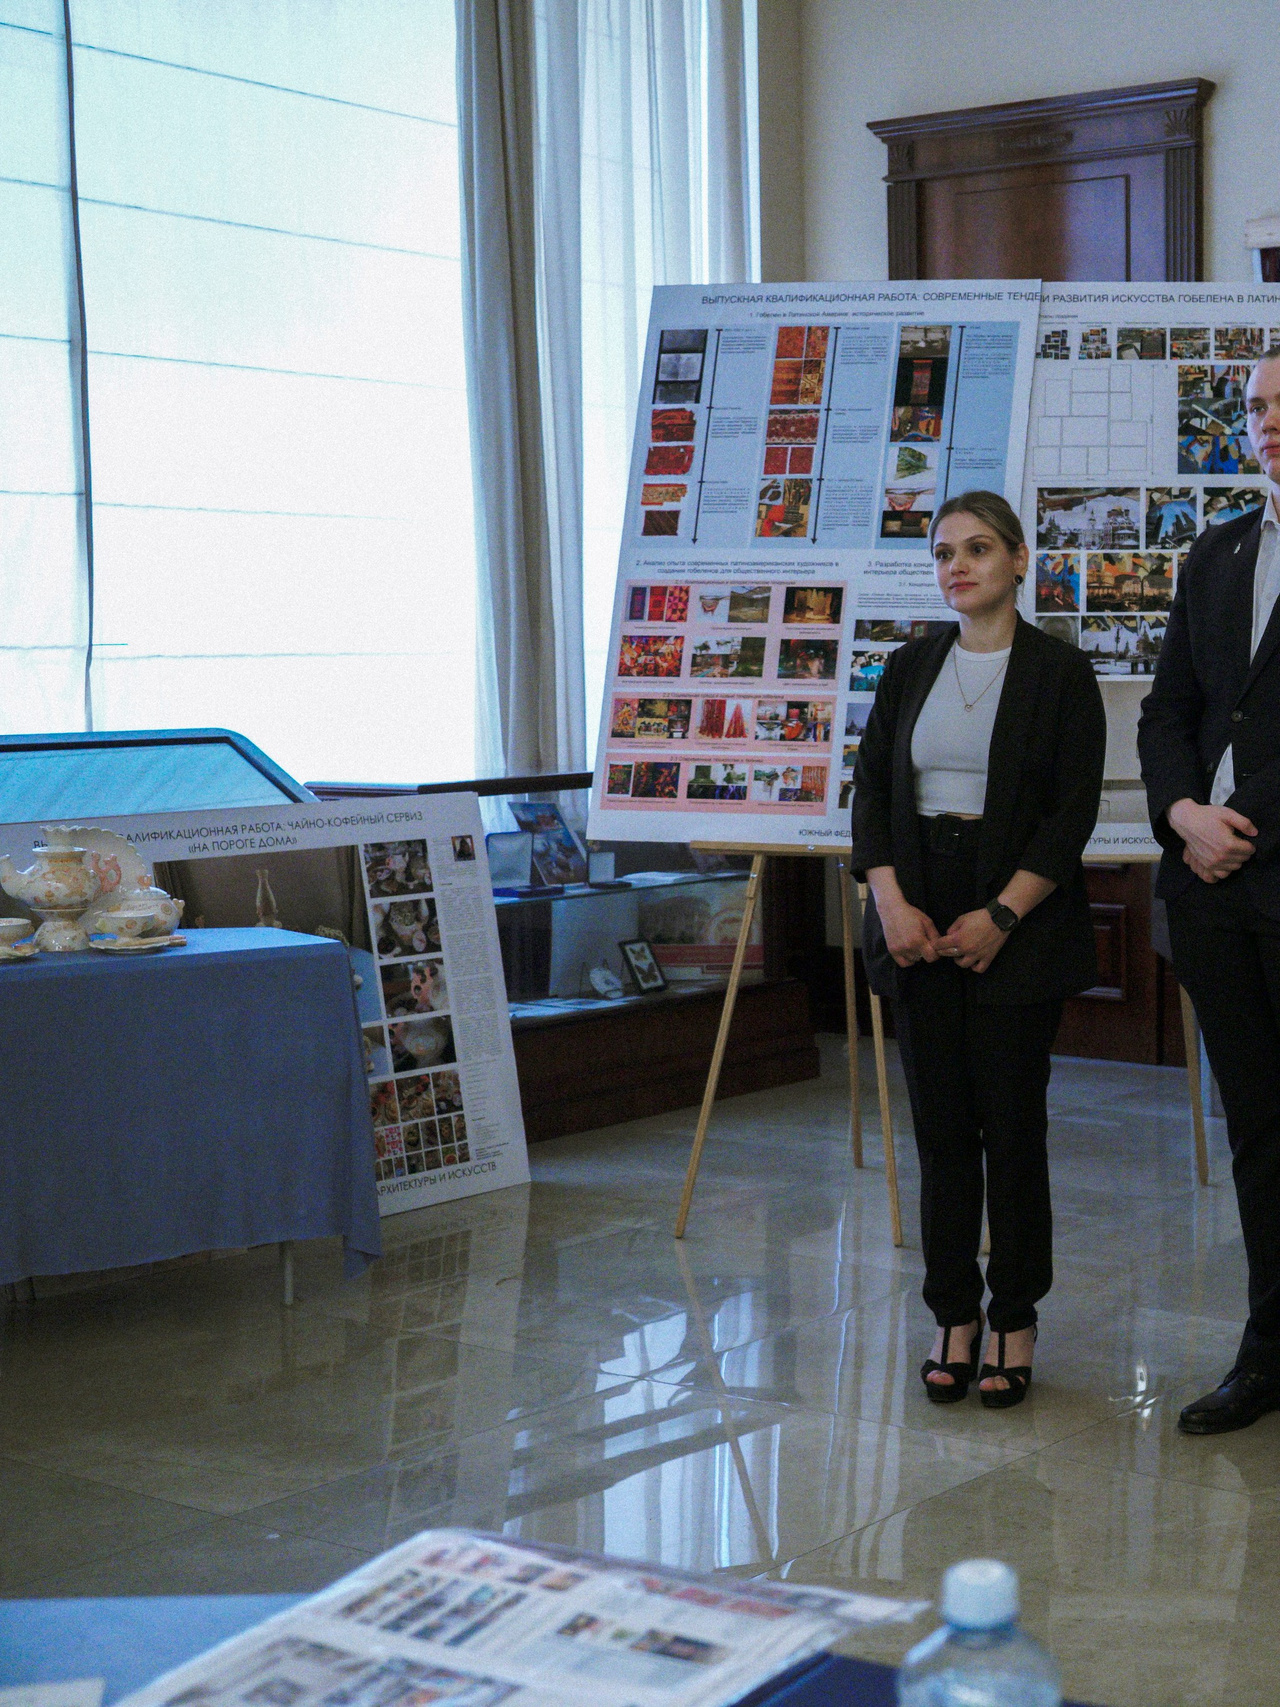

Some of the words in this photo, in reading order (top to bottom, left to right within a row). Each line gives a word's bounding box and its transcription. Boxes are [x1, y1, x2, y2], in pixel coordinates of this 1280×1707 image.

[701, 294, 763, 305] ВЫПУСКНАЯ
[765, 293, 875, 304] КВАЛИФИКАЦИОННАЯ
[922, 292, 1004, 301] СОВРЕМЕННЫЕ
[1053, 294, 1108, 303] РАЗВИТИЯ
[1112, 294, 1175, 303] ИСКУССТВА
[1178, 294, 1235, 303] ГОБЕЛЕНА
[1237, 294, 1244, 303] В
[119, 824, 238, 843] АЛИФИКАЦИОННАЯ
[241, 821, 286, 834] РАБОТА:
[287, 813, 385, 830] ЧАЙНО-КОФЕЙНЫЙ
[386, 811, 423, 823] СЕРВИЗ
[799, 828, 833, 837] ЮЖНЫЙ
[834, 830, 852, 838] ФЕД
[188, 843, 210, 853] «НА
[212, 838, 256, 851] ПОРОГЕ
[258, 836, 298, 848] ДОМА»
[439, 1173, 446, 1182] И
[448, 1161, 497, 1180] ИСКУССТВ
